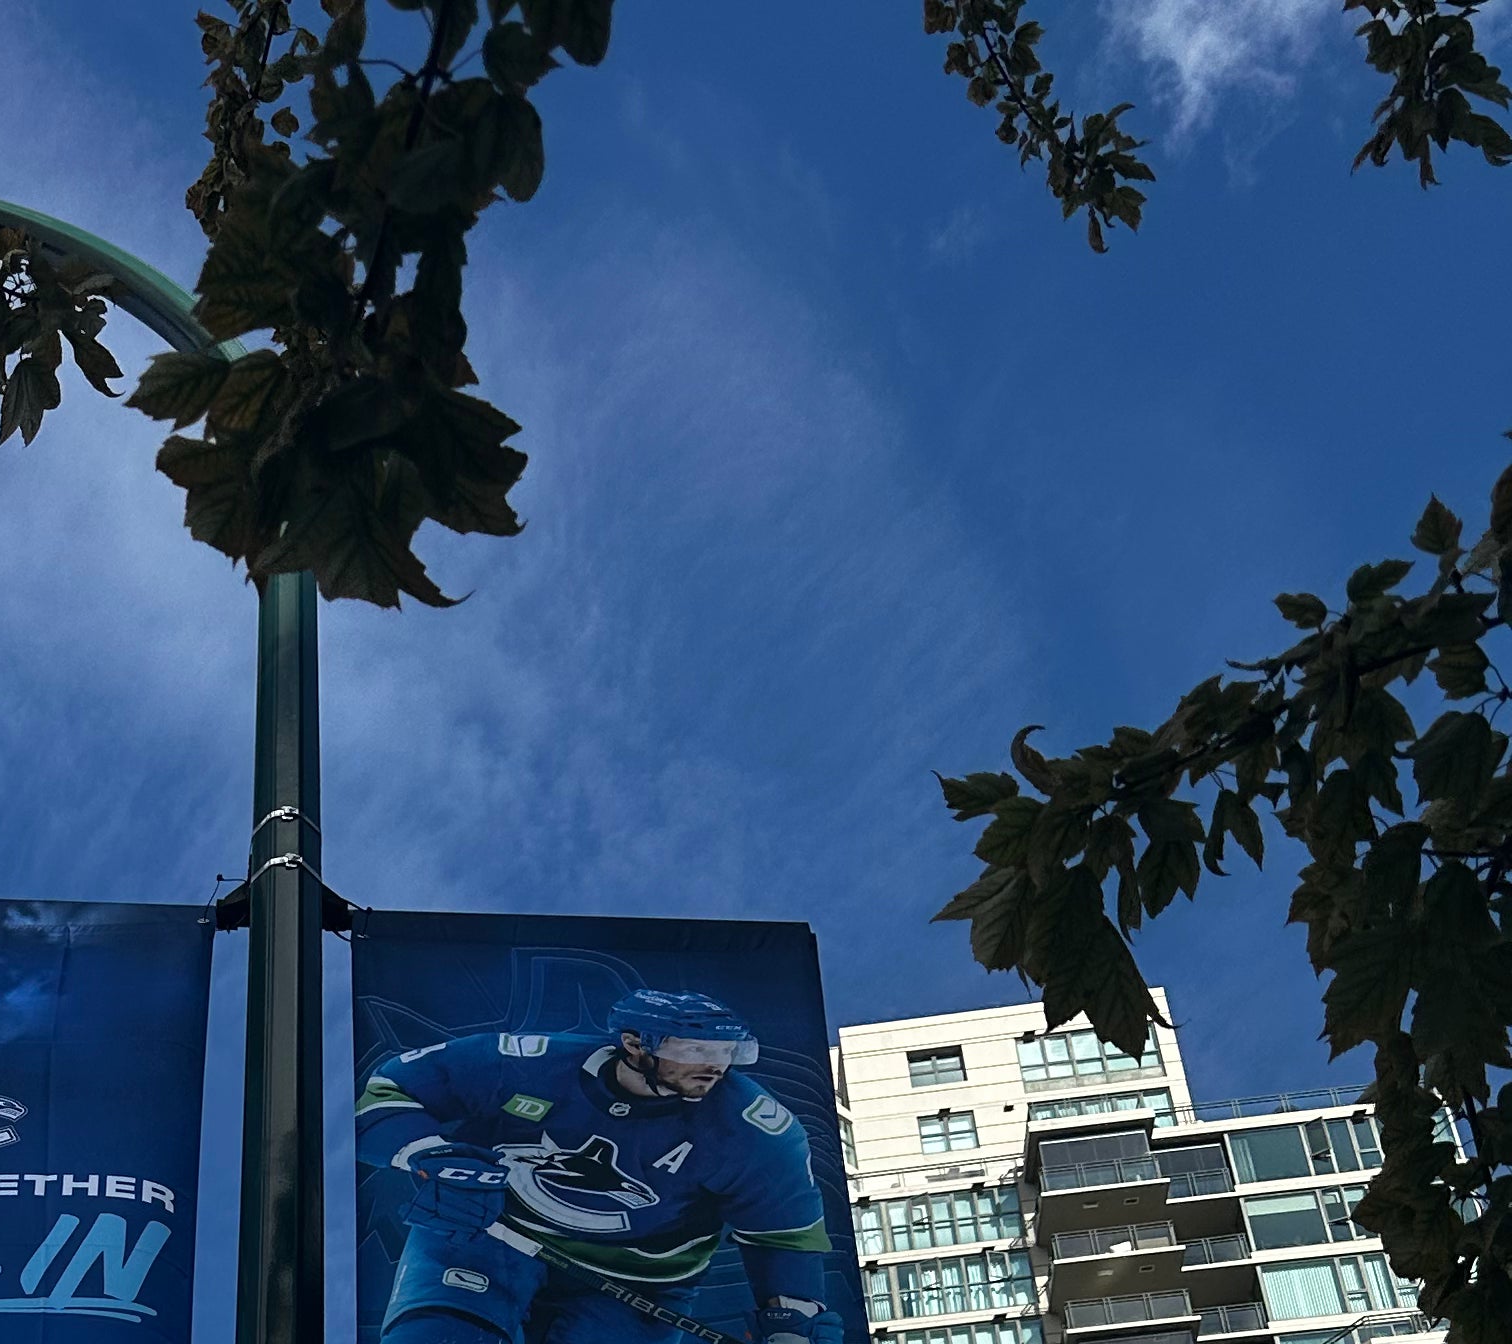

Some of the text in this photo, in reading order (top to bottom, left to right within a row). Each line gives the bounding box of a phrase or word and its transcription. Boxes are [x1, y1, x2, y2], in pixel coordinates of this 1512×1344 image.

[514, 1099, 545, 1116] TD
[652, 1140, 694, 1174] A
[20, 1213, 172, 1309] IN
[600, 1282, 724, 1344] RIBCOR
